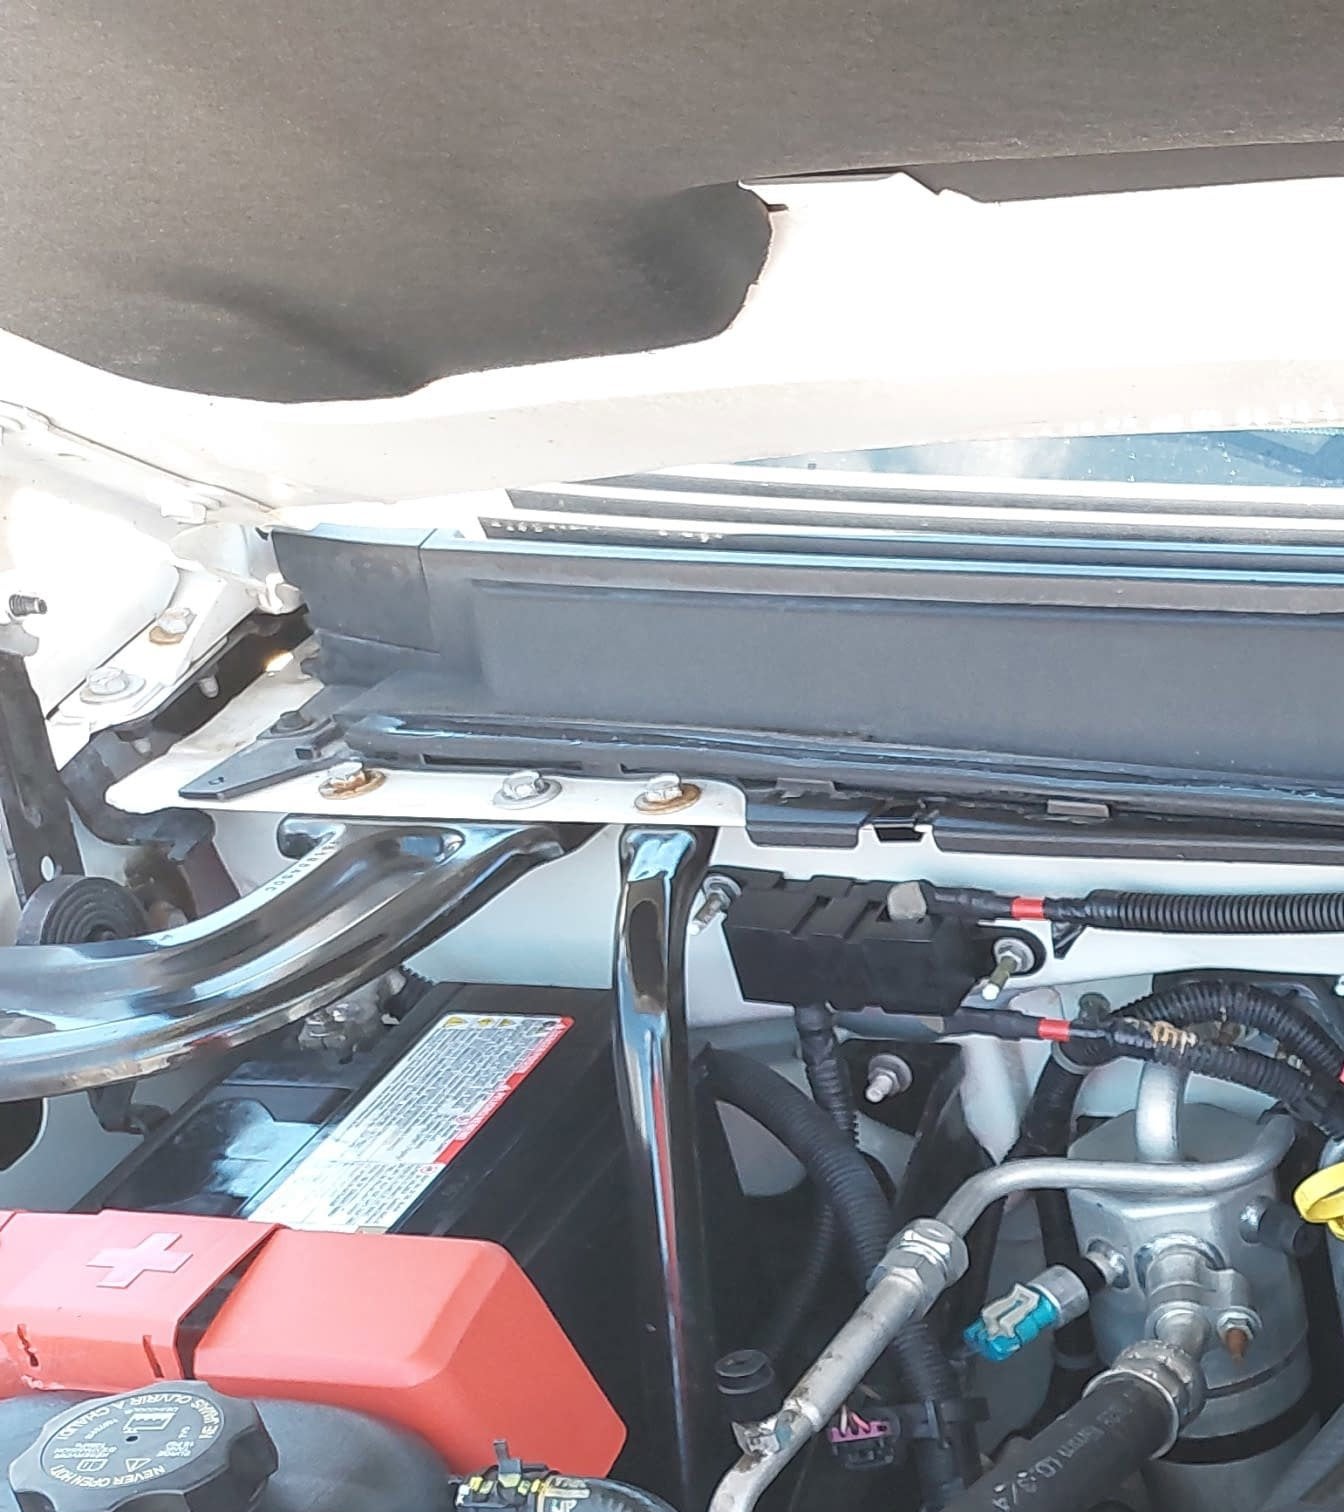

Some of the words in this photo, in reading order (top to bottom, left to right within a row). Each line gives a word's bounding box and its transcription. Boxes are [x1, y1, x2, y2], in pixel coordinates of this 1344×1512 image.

[130, 1393, 193, 1406] OUVRIR
[74, 1474, 112, 1487] OPEN
[114, 1465, 166, 1485] NEVER
